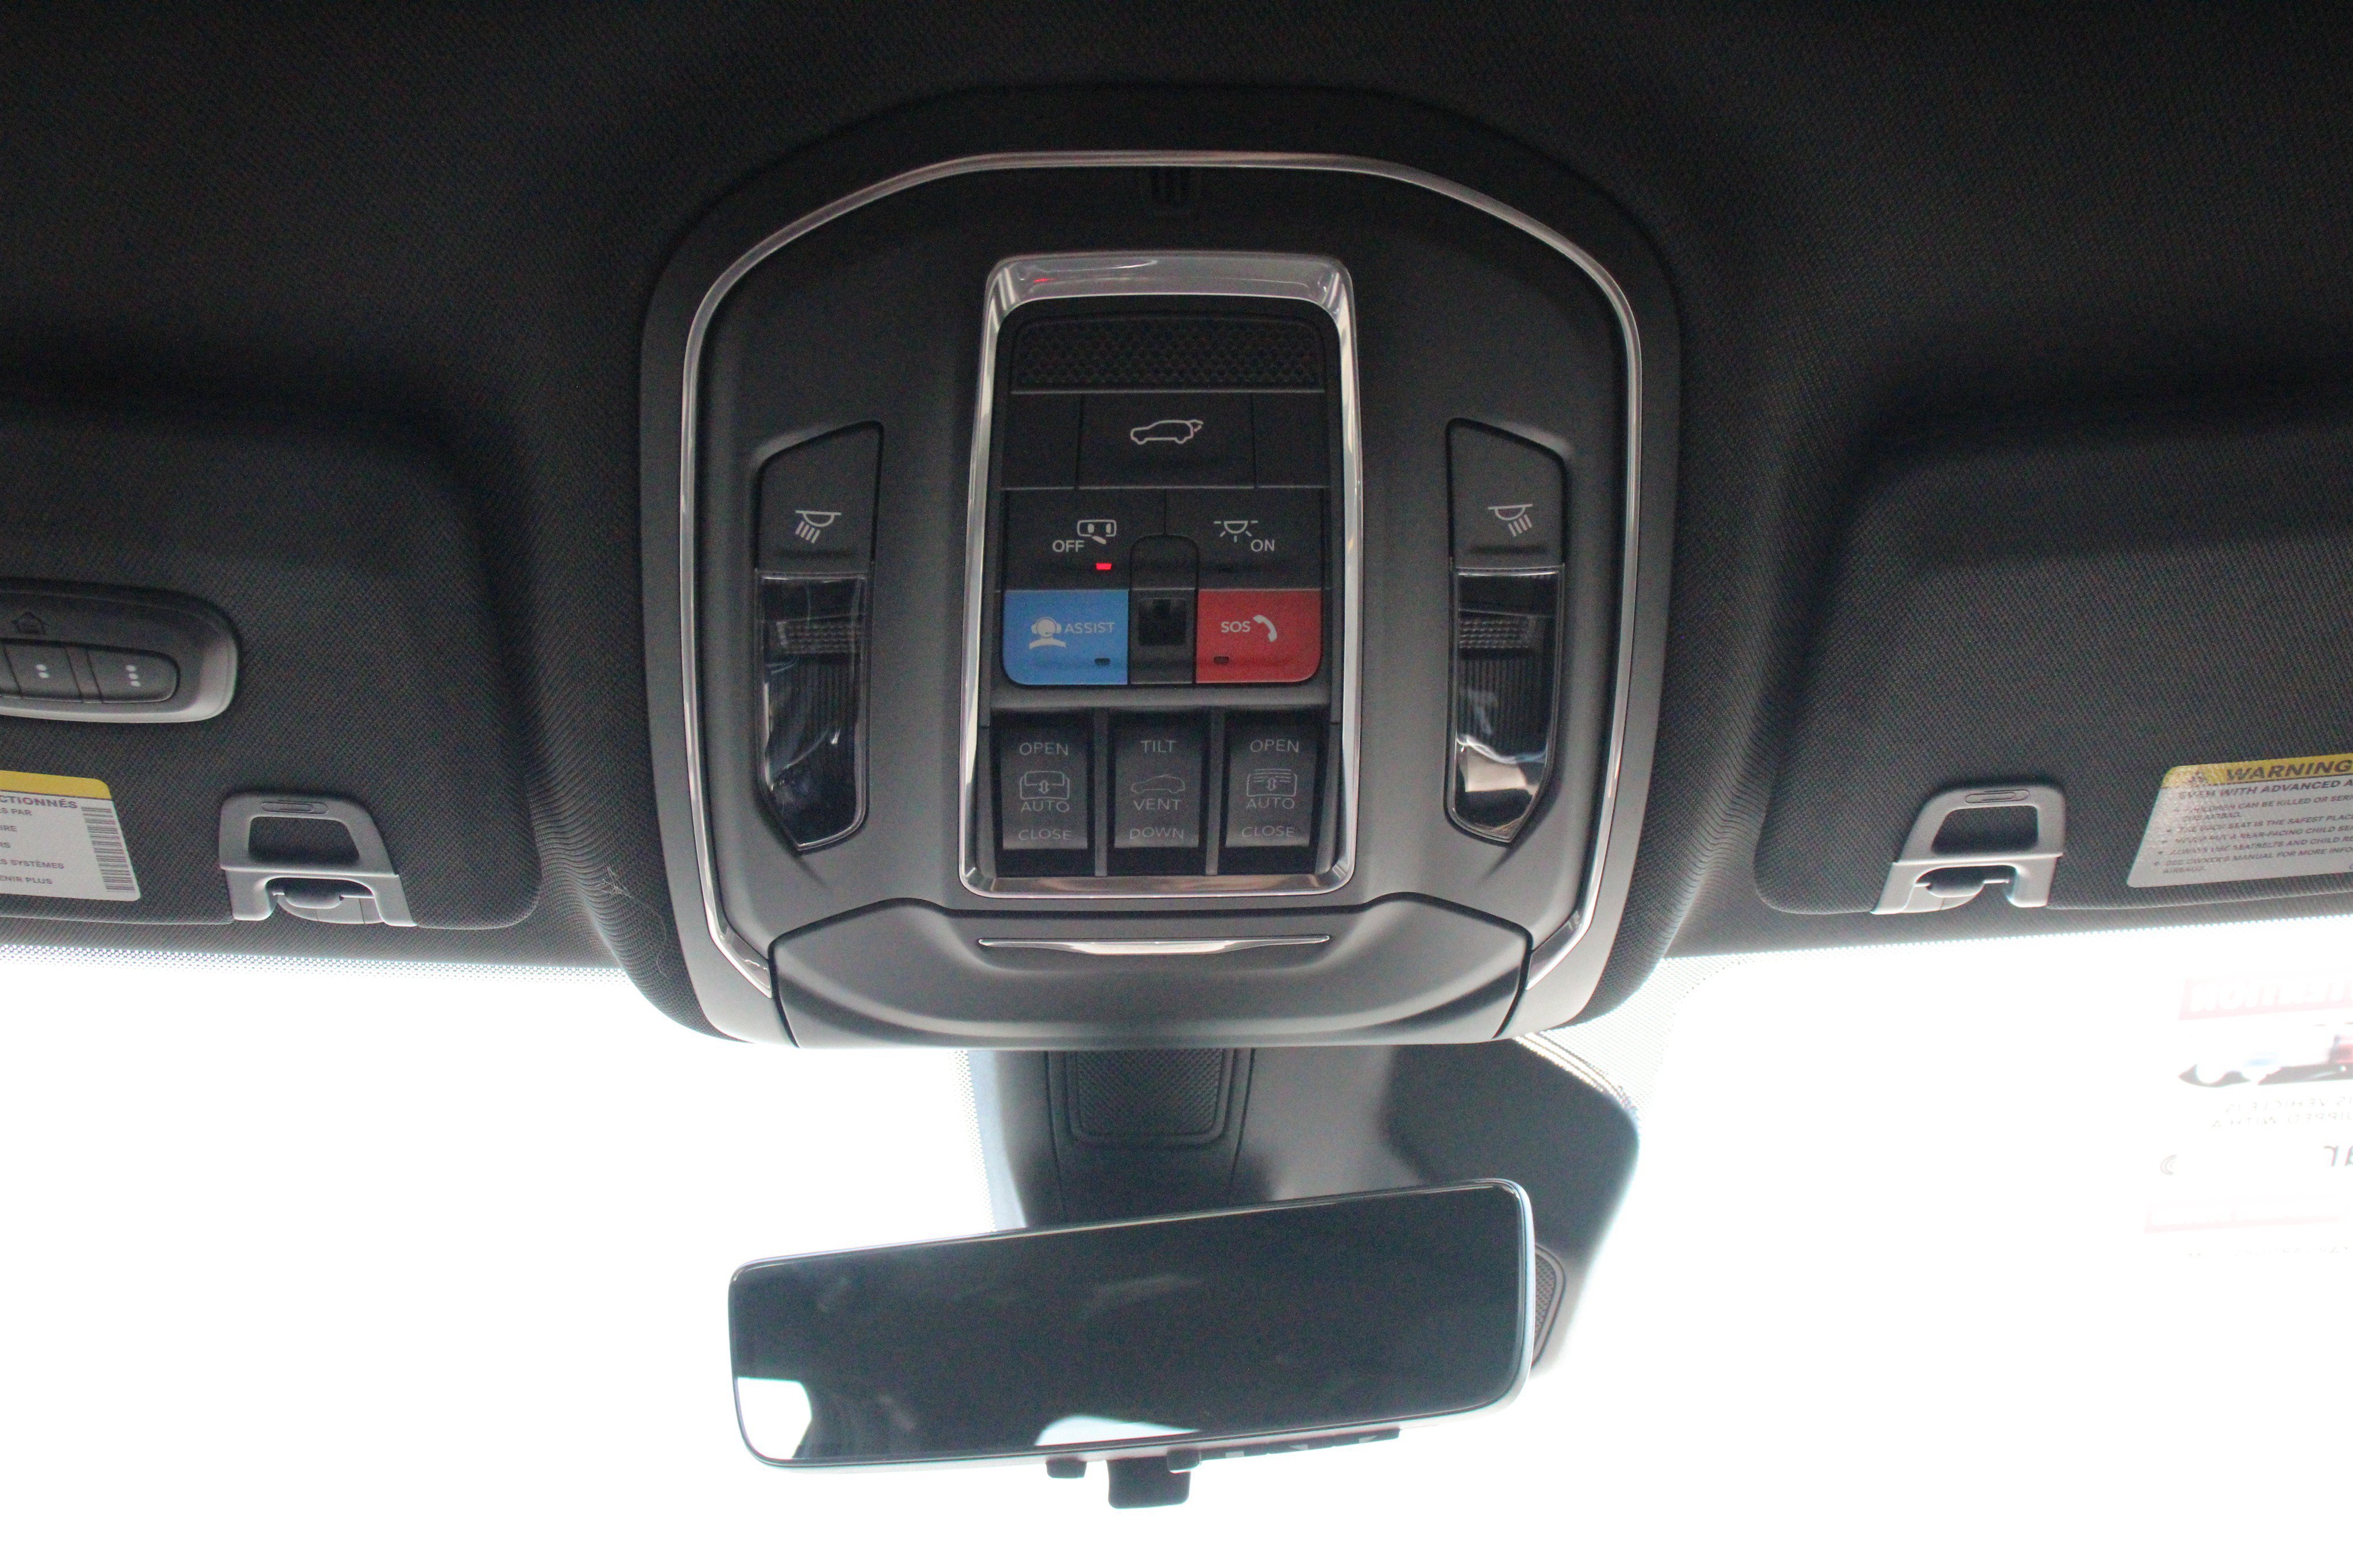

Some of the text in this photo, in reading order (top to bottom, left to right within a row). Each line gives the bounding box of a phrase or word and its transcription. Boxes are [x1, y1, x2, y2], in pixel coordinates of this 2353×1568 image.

[1052, 540, 1085, 553] OFF
[1250, 540, 1275, 553] ON
[1064, 623, 1115, 634] ASSIST
[1221, 621, 1251, 633] SOS
[1019, 743, 1069, 756] OPEN
[1141, 740, 1177, 753] TILT
[1249, 740, 1299, 753] OPEN
[2227, 759, 2353, 781] WARNING
[2220, 786, 2257, 796] WITH
[2261, 780, 2341, 793] ADVANCED
[1020, 800, 1070, 813] AUTO
[1133, 798, 1182, 811] VENT
[1246, 797, 1295, 810] AUTO
[2184, 804, 2235, 814] HILDREN
[2238, 801, 2259, 809] CAN
[2276, 798, 2312, 806] KILLED
[2287, 816, 2324, 824] SAFEST
[1019, 829, 1072, 841] CLOSE
[1129, 827, 1184, 840] DOWN
[1241, 825, 1295, 837] CLOSE
[2240, 828, 2304, 839] REAR-FACING
[2305, 826, 2336, 834] CHILD
[2233, 841, 2284, 850] SEATBELTS
[2285, 839, 2308, 847] AND
[2309, 836, 2340, 844] CHILD
[2232, 852, 2274, 861] MANUAL
[2298, 848, 2327, 856] MORE
[10, 859, 64, 869] SYSTÈMES
[25, 876, 53, 885] PLUS
